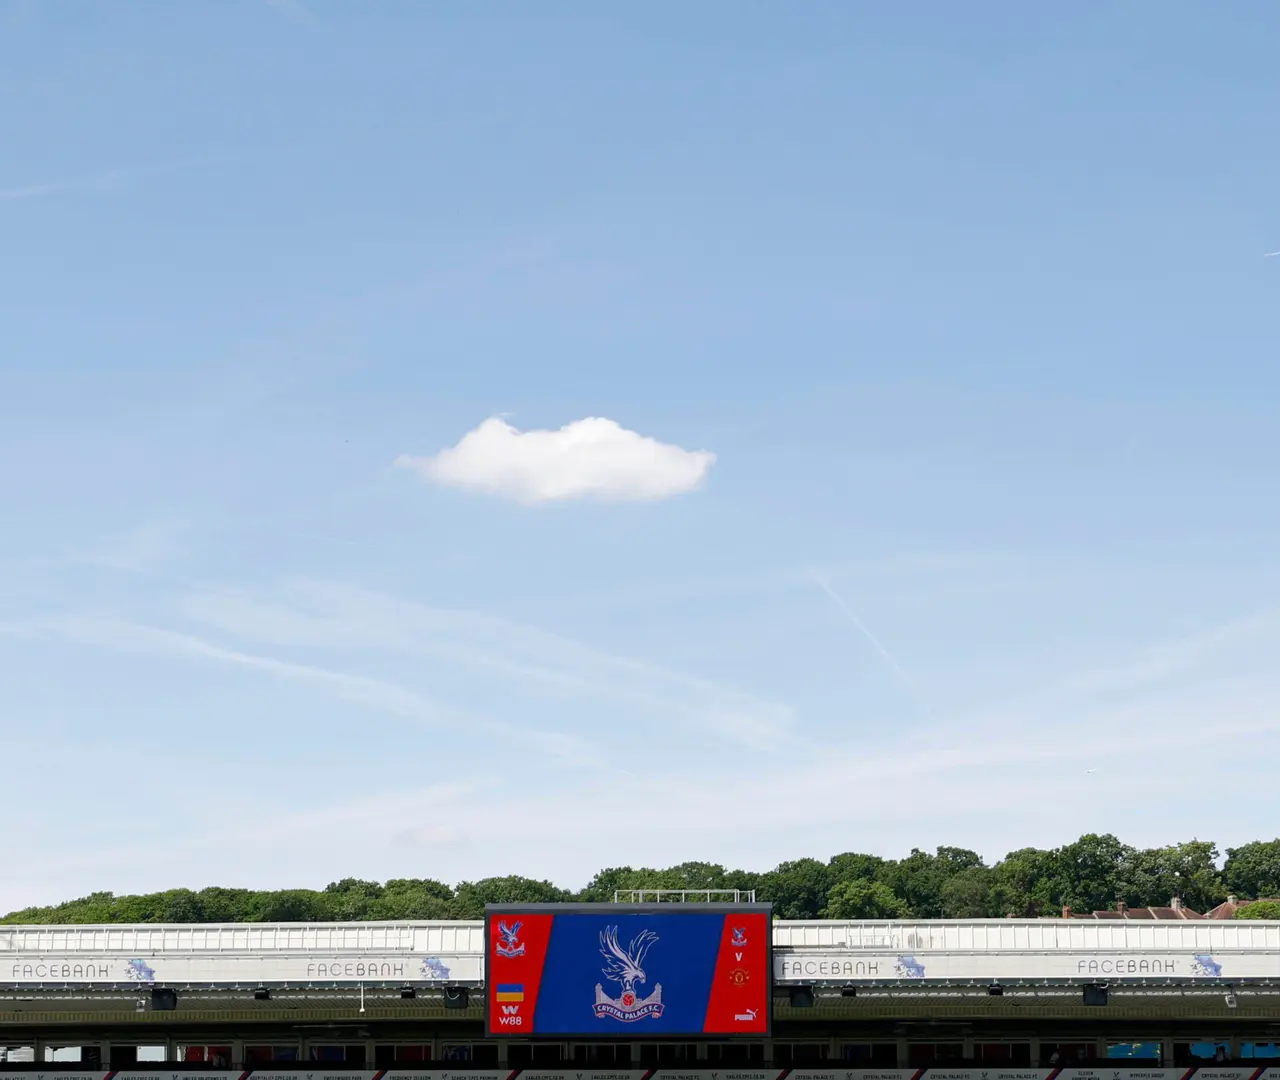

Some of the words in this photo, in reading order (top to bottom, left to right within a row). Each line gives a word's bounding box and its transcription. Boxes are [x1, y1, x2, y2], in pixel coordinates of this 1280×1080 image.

[13, 964, 110, 977] FACEBANK
[307, 963, 403, 977] FACEBANK
[782, 962, 879, 975] FACEBANK
[1078, 960, 1175, 973] FACEBANK
[596, 1005, 624, 1020] CRYSTAL
[624, 1008, 648, 1021] PALACE
[499, 1016, 522, 1026] W88
